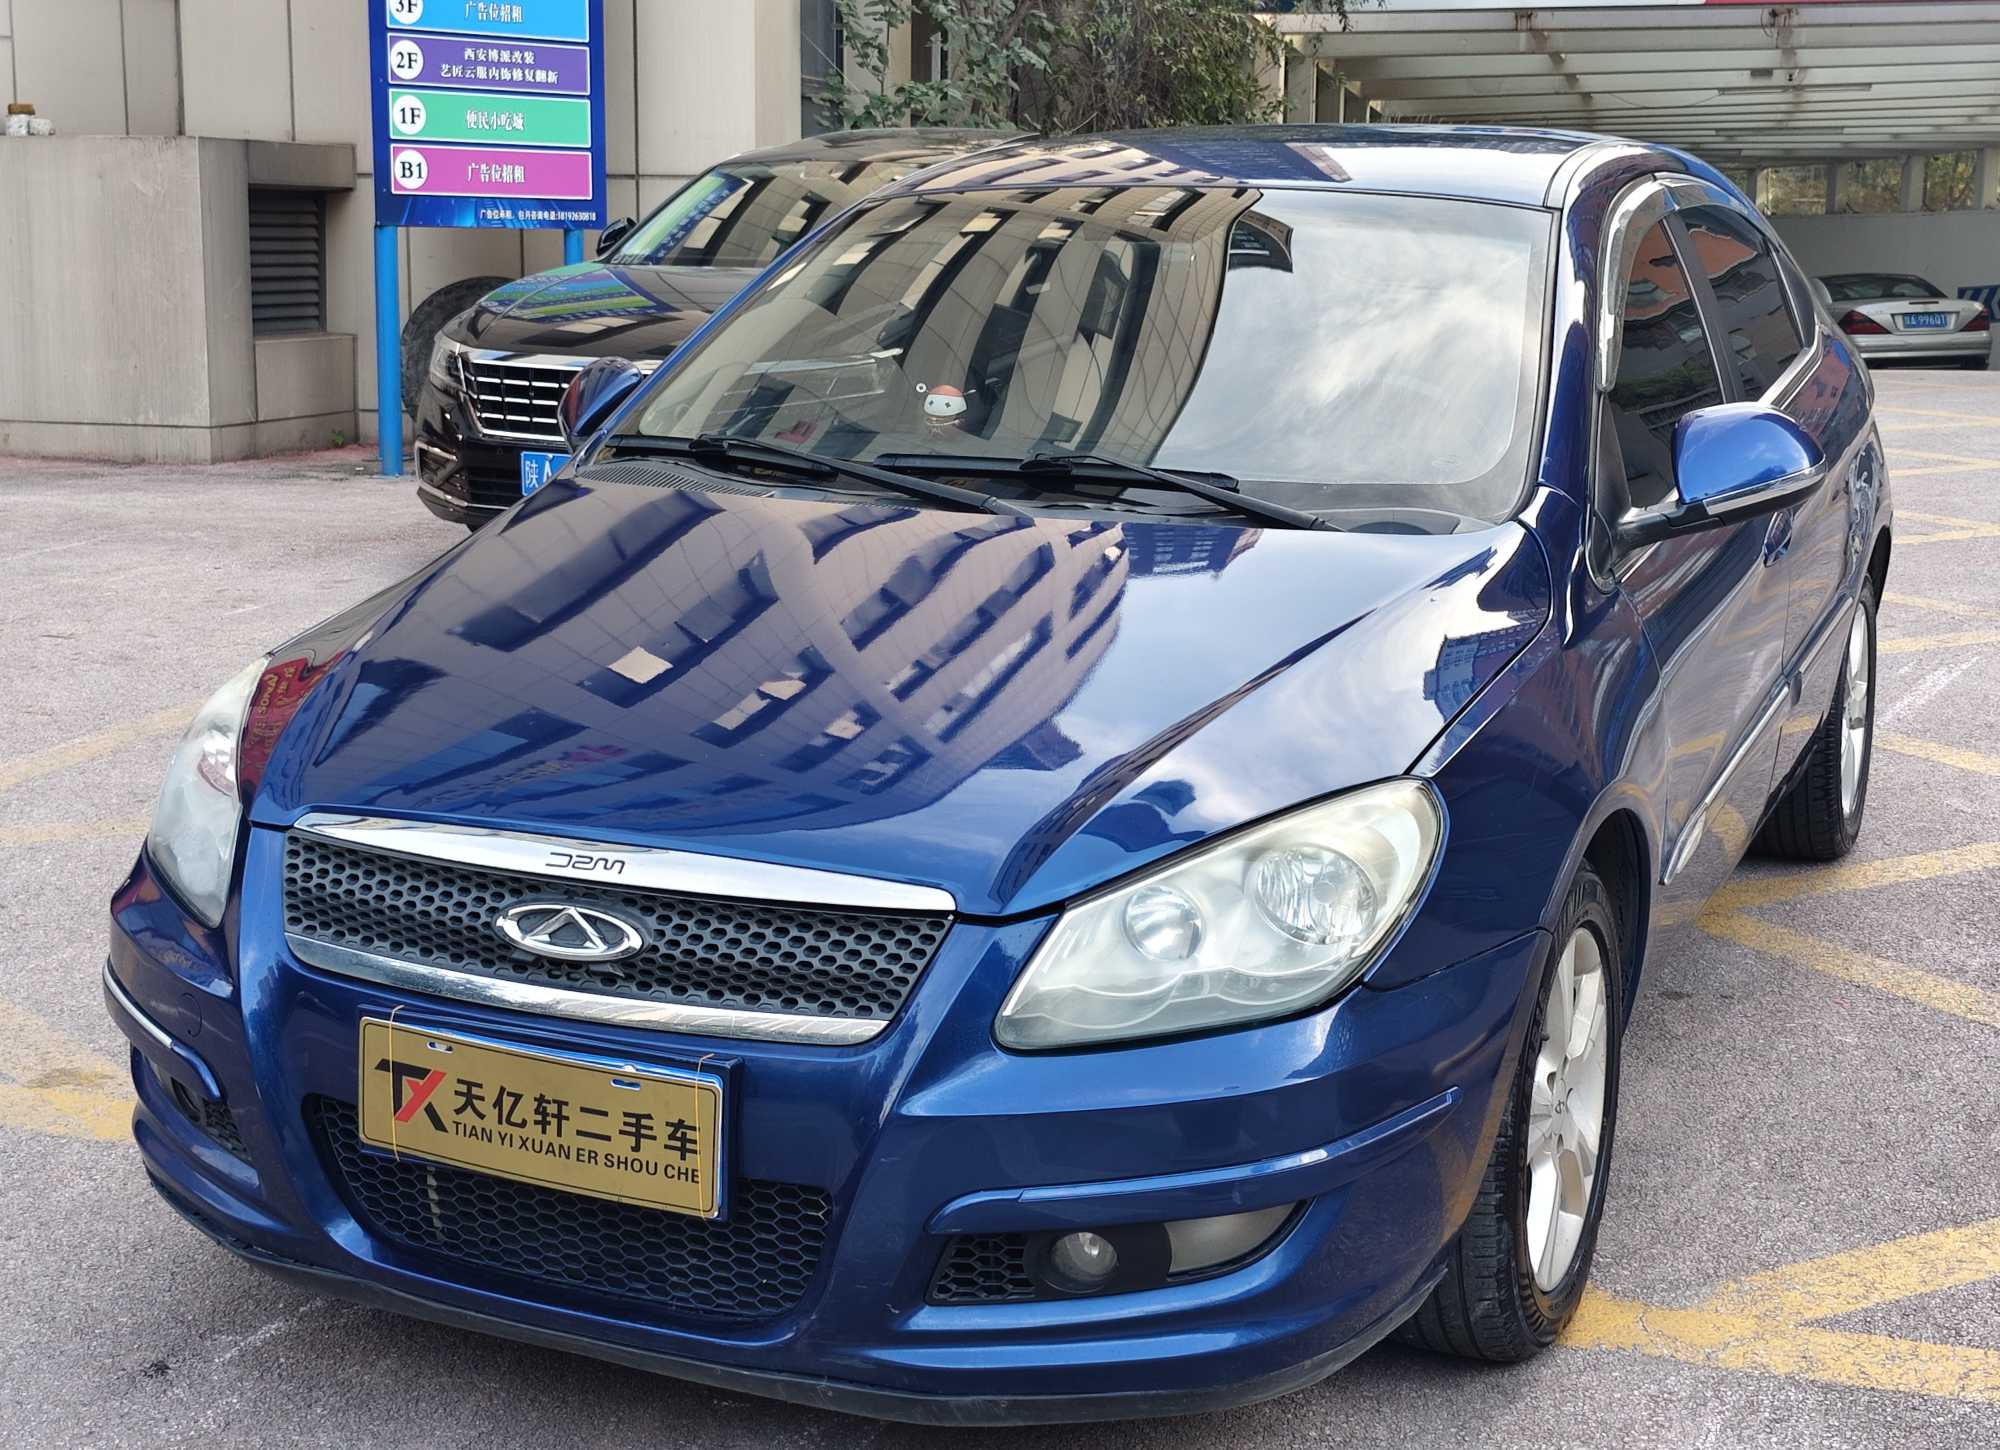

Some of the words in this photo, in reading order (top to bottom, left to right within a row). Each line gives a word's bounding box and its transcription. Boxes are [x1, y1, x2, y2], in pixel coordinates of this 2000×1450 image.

[465, 1, 523, 23] 广告位招租
[396, 51, 418, 69] 2F
[400, 107, 421, 125] 1F
[466, 110, 524, 131] 便民小吃城
[400, 161, 424, 179] B1
[467, 162, 525, 183] 广告位招租
[453, 1078, 700, 1161] 天亿轩二手车
[452, 1120, 493, 1144] TIAN
[498, 1131, 513, 1148] YI
[519, 1136, 571, 1160] XUAN
[576, 1148, 599, 1166] ER
[604, 1153, 658, 1176] SHOU
[664, 1164, 700, 1184] CHE
